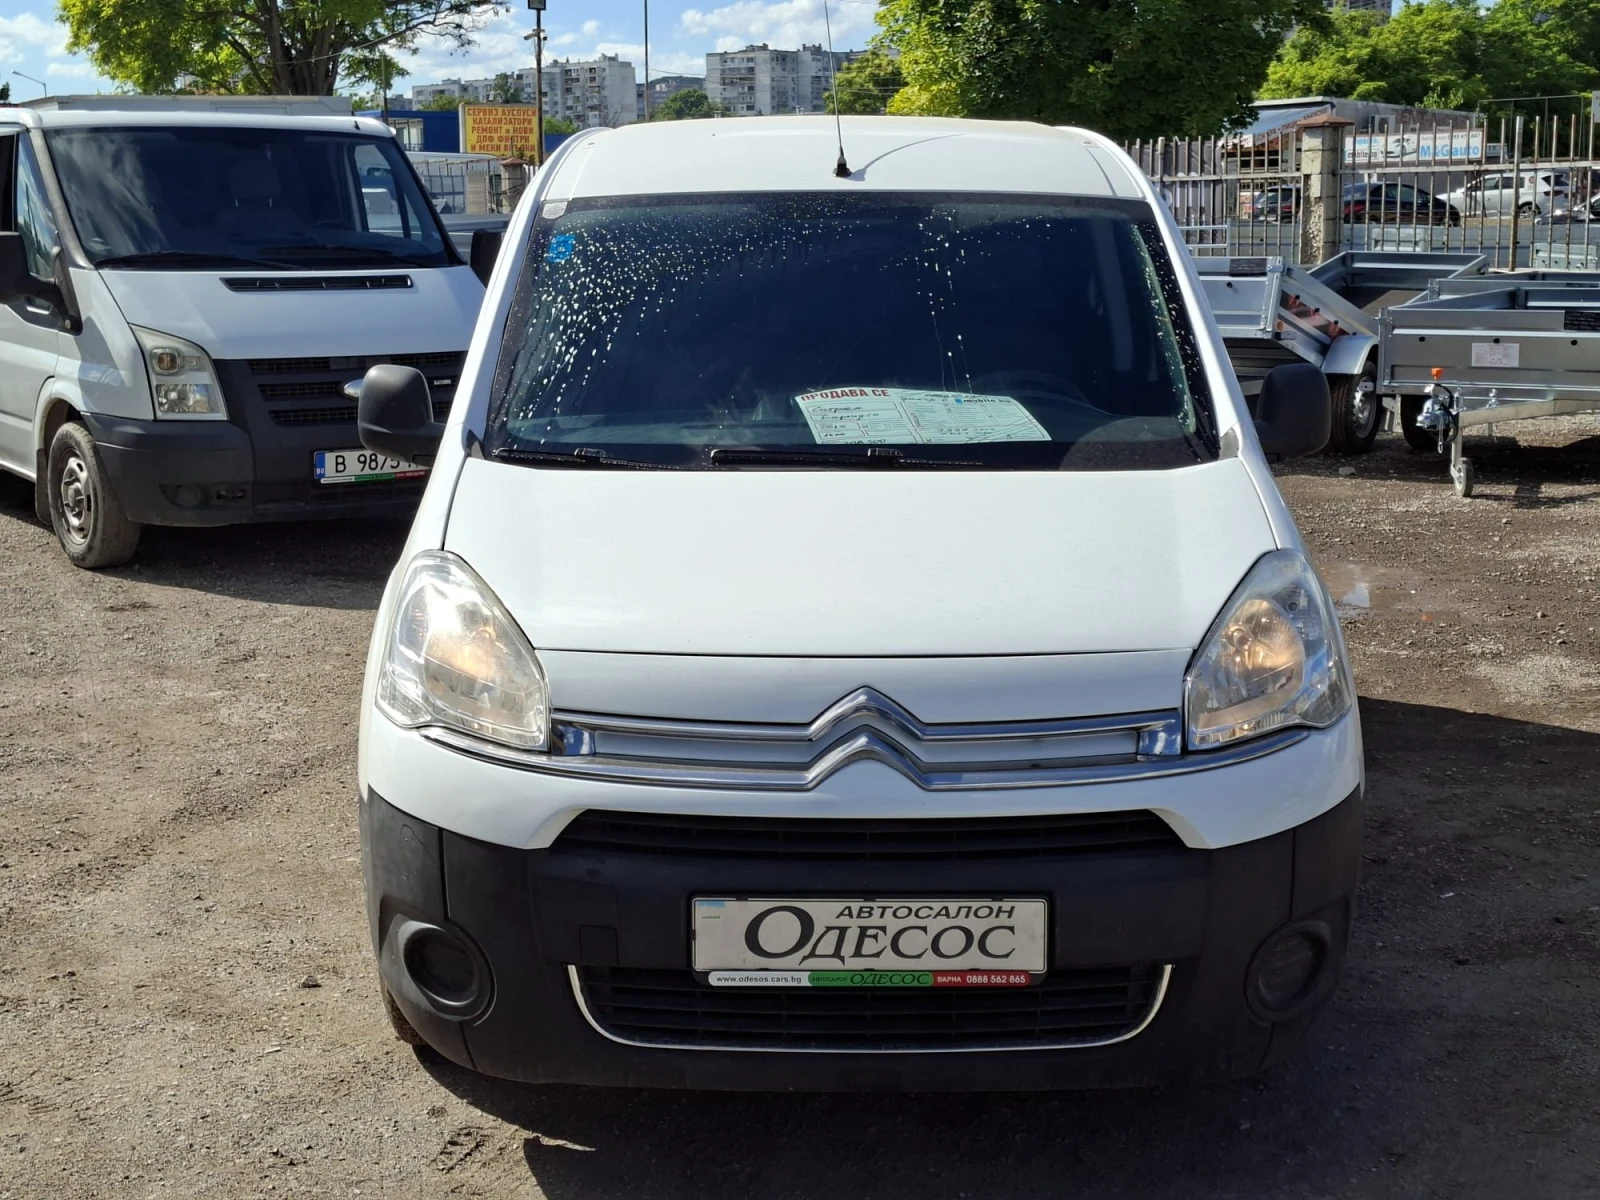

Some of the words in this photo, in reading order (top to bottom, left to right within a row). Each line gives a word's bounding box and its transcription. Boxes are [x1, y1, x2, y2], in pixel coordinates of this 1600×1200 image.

[468, 108, 498, 116] СЕРВИЗ
[502, 108, 536, 116] АУСПУСИ
[472, 118, 532, 126] КАТАЛИЗАТОРИ
[472, 126, 502, 134] РЕМОНТ
[476, 136, 496, 144] ДПФ
[1420, 144, 1480, 158] M&Gauo
[800, 388, 871, 402] ПРОДАВА
[871, 388, 890, 397] СЕ
[335, 454, 347, 473] B
[835, 905, 1016, 920] АВТОСАЛОН
[716, 975, 802, 985] www.odesos.cars.bg
[850, 972, 931, 986] ОДЕСОС
[966, 975, 989, 984] 0888
[990, 975, 1008, 984] 562
[1009, 975, 1026, 984] 865
